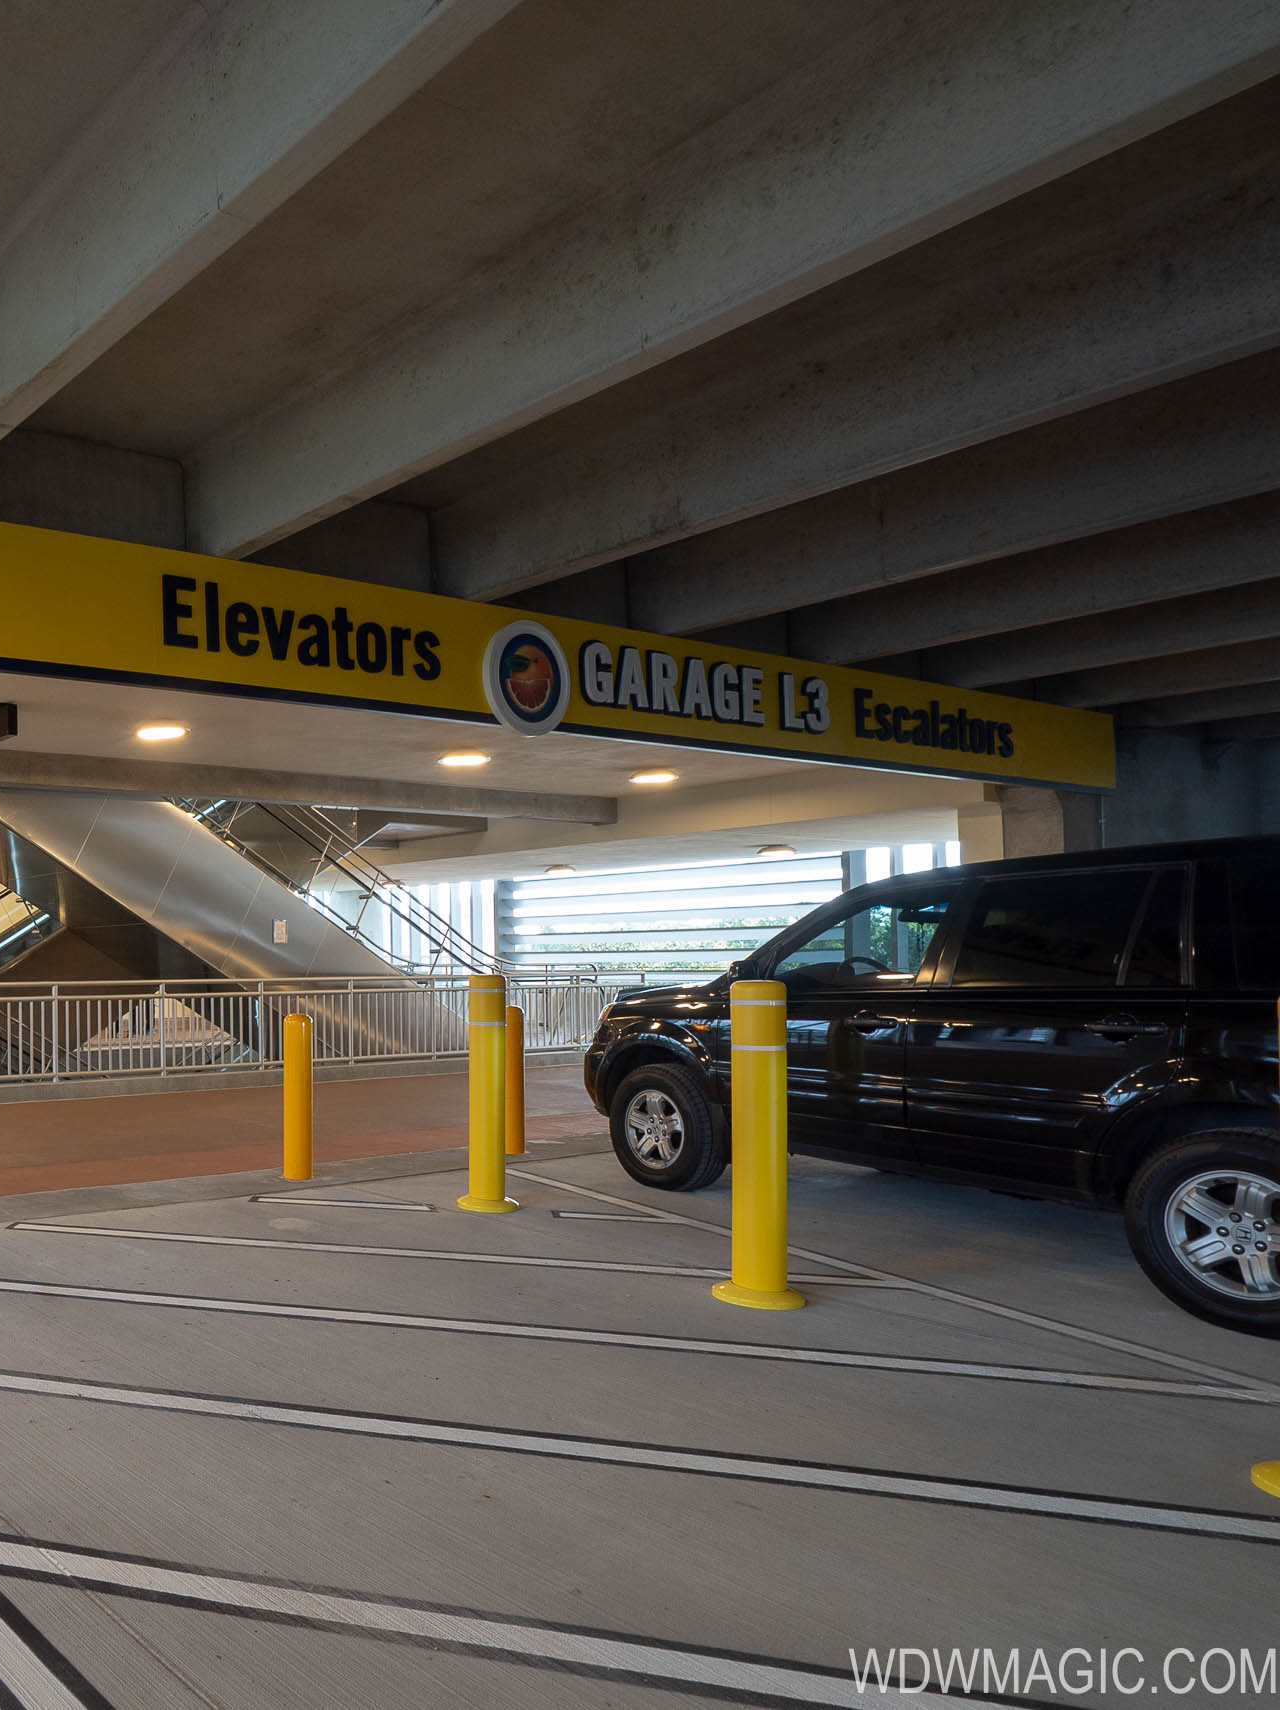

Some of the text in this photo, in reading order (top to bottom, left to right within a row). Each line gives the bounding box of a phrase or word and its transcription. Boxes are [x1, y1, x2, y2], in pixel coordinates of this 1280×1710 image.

[162, 573, 1015, 758] Elevators GARAGE L3 Escalators
